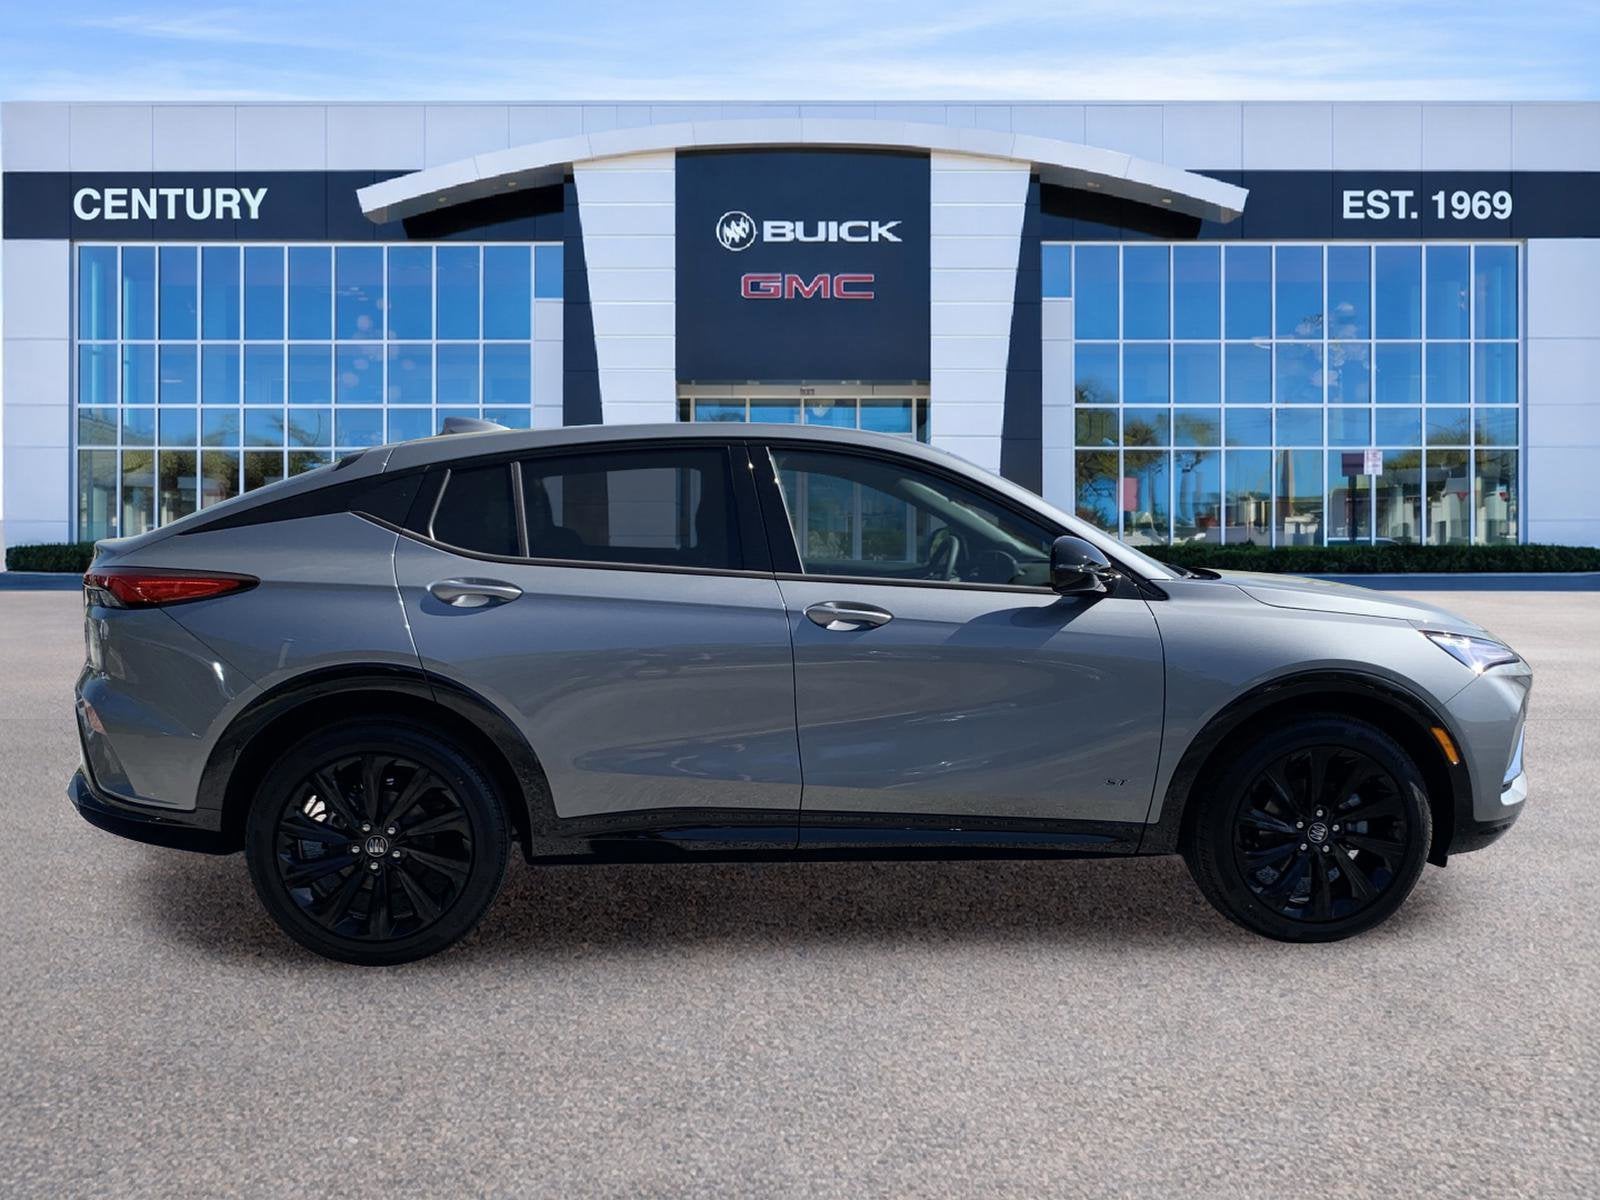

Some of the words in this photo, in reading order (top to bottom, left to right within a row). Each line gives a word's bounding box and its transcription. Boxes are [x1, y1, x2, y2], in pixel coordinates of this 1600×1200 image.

[73, 187, 268, 221] CENTURY
[1342, 189, 1418, 220] EST.
[1431, 190, 1513, 220] 1969
[762, 220, 903, 243] BUICK
[741, 273, 875, 300] GMC
